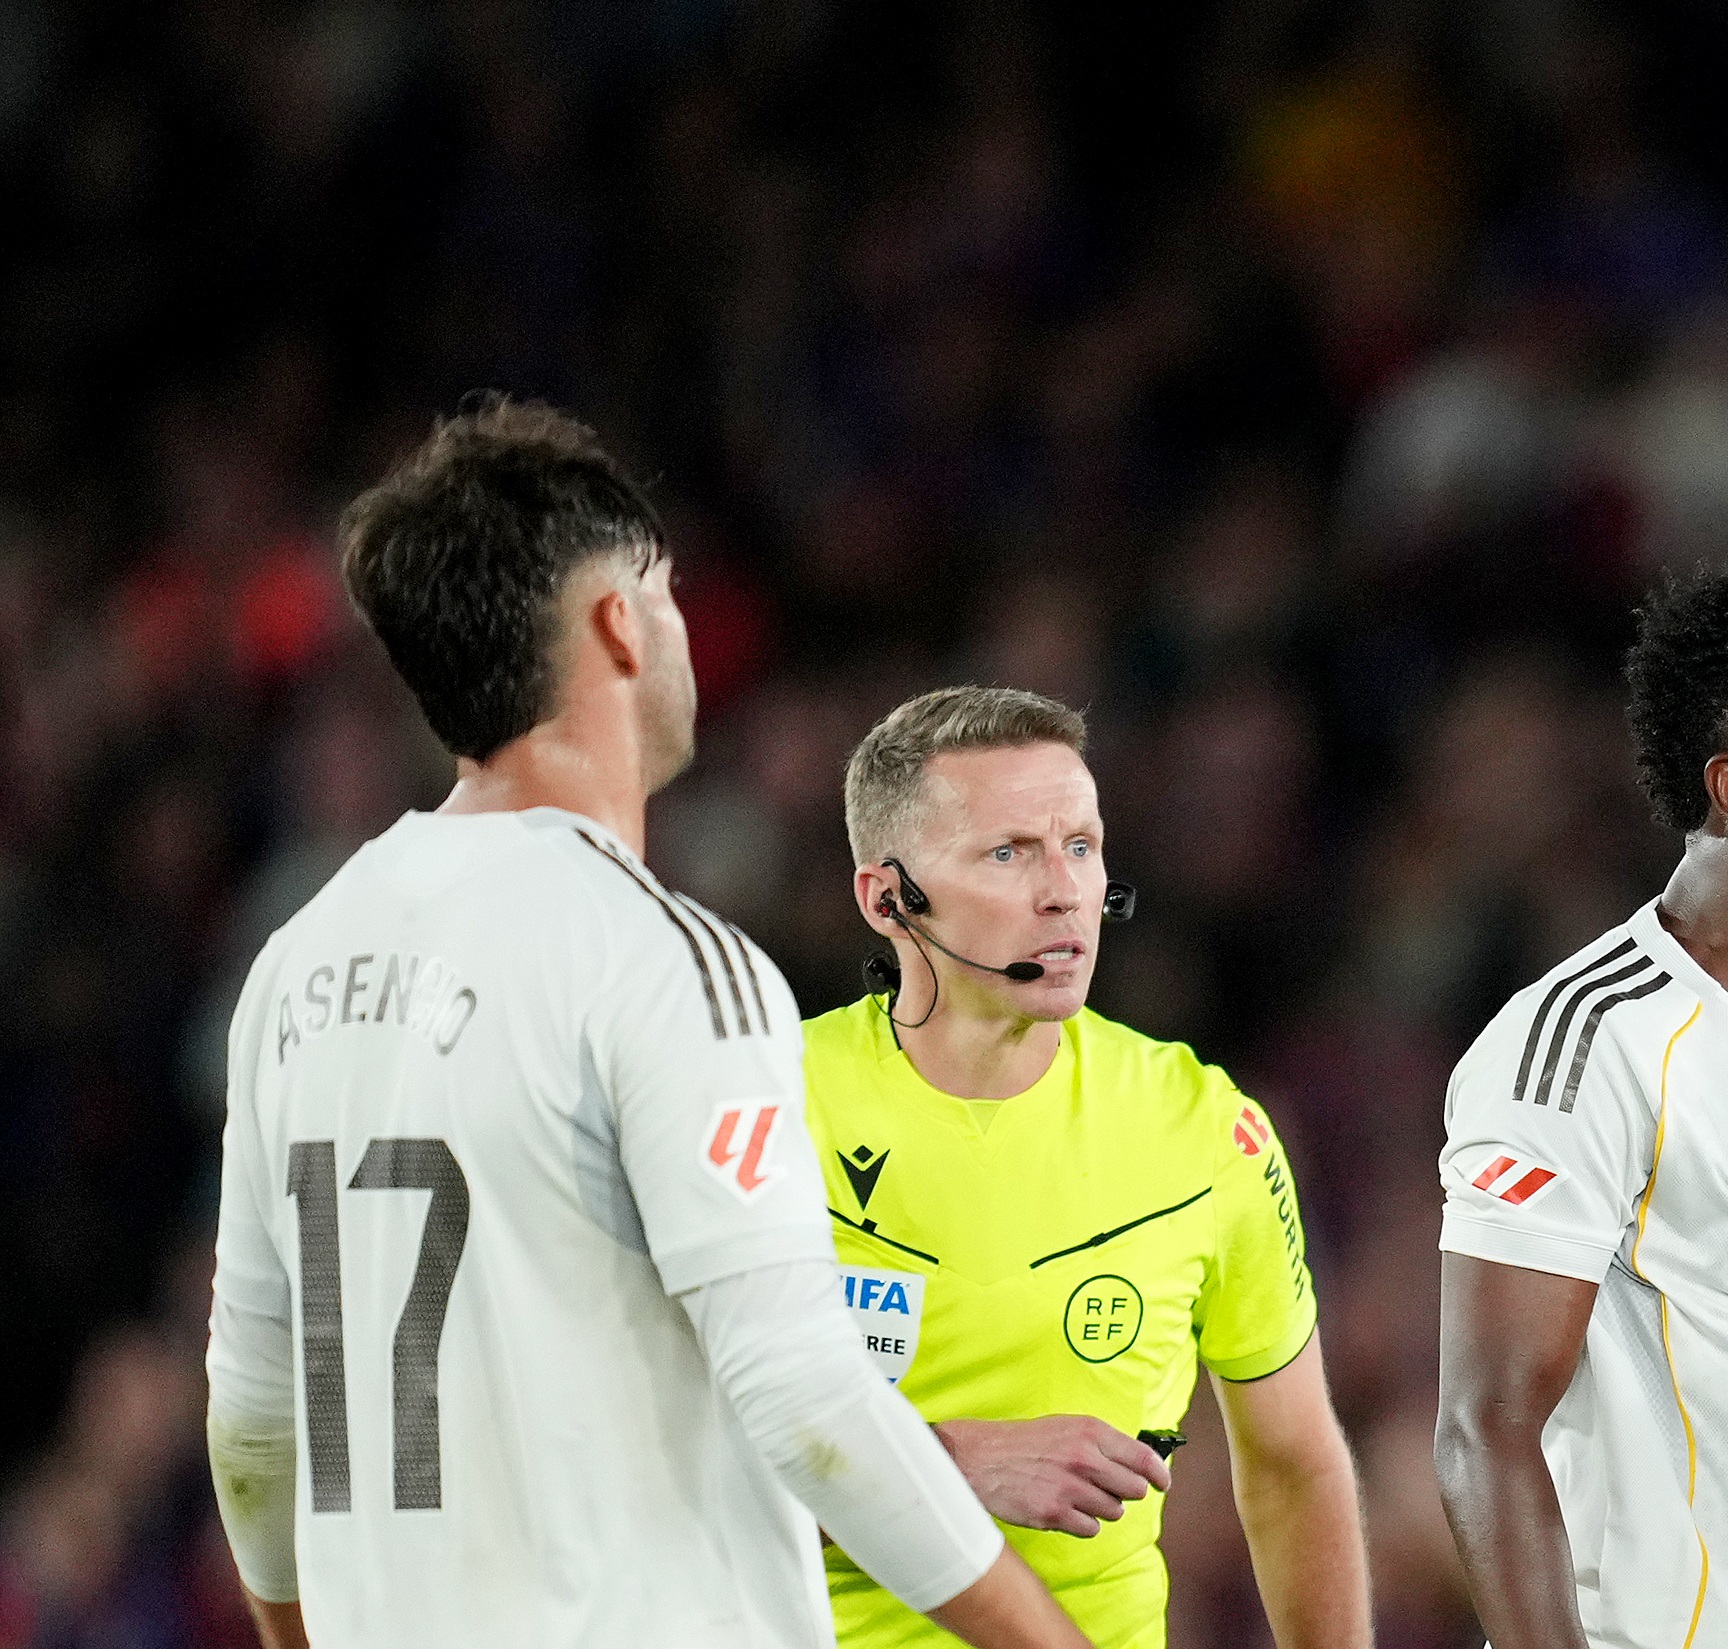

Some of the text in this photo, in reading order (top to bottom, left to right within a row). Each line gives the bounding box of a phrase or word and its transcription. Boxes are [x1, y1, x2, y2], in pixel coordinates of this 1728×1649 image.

[278, 953, 477, 1067] ASENO
[286, 1138, 470, 1514] 17
[840, 1275, 910, 1315] IFA
